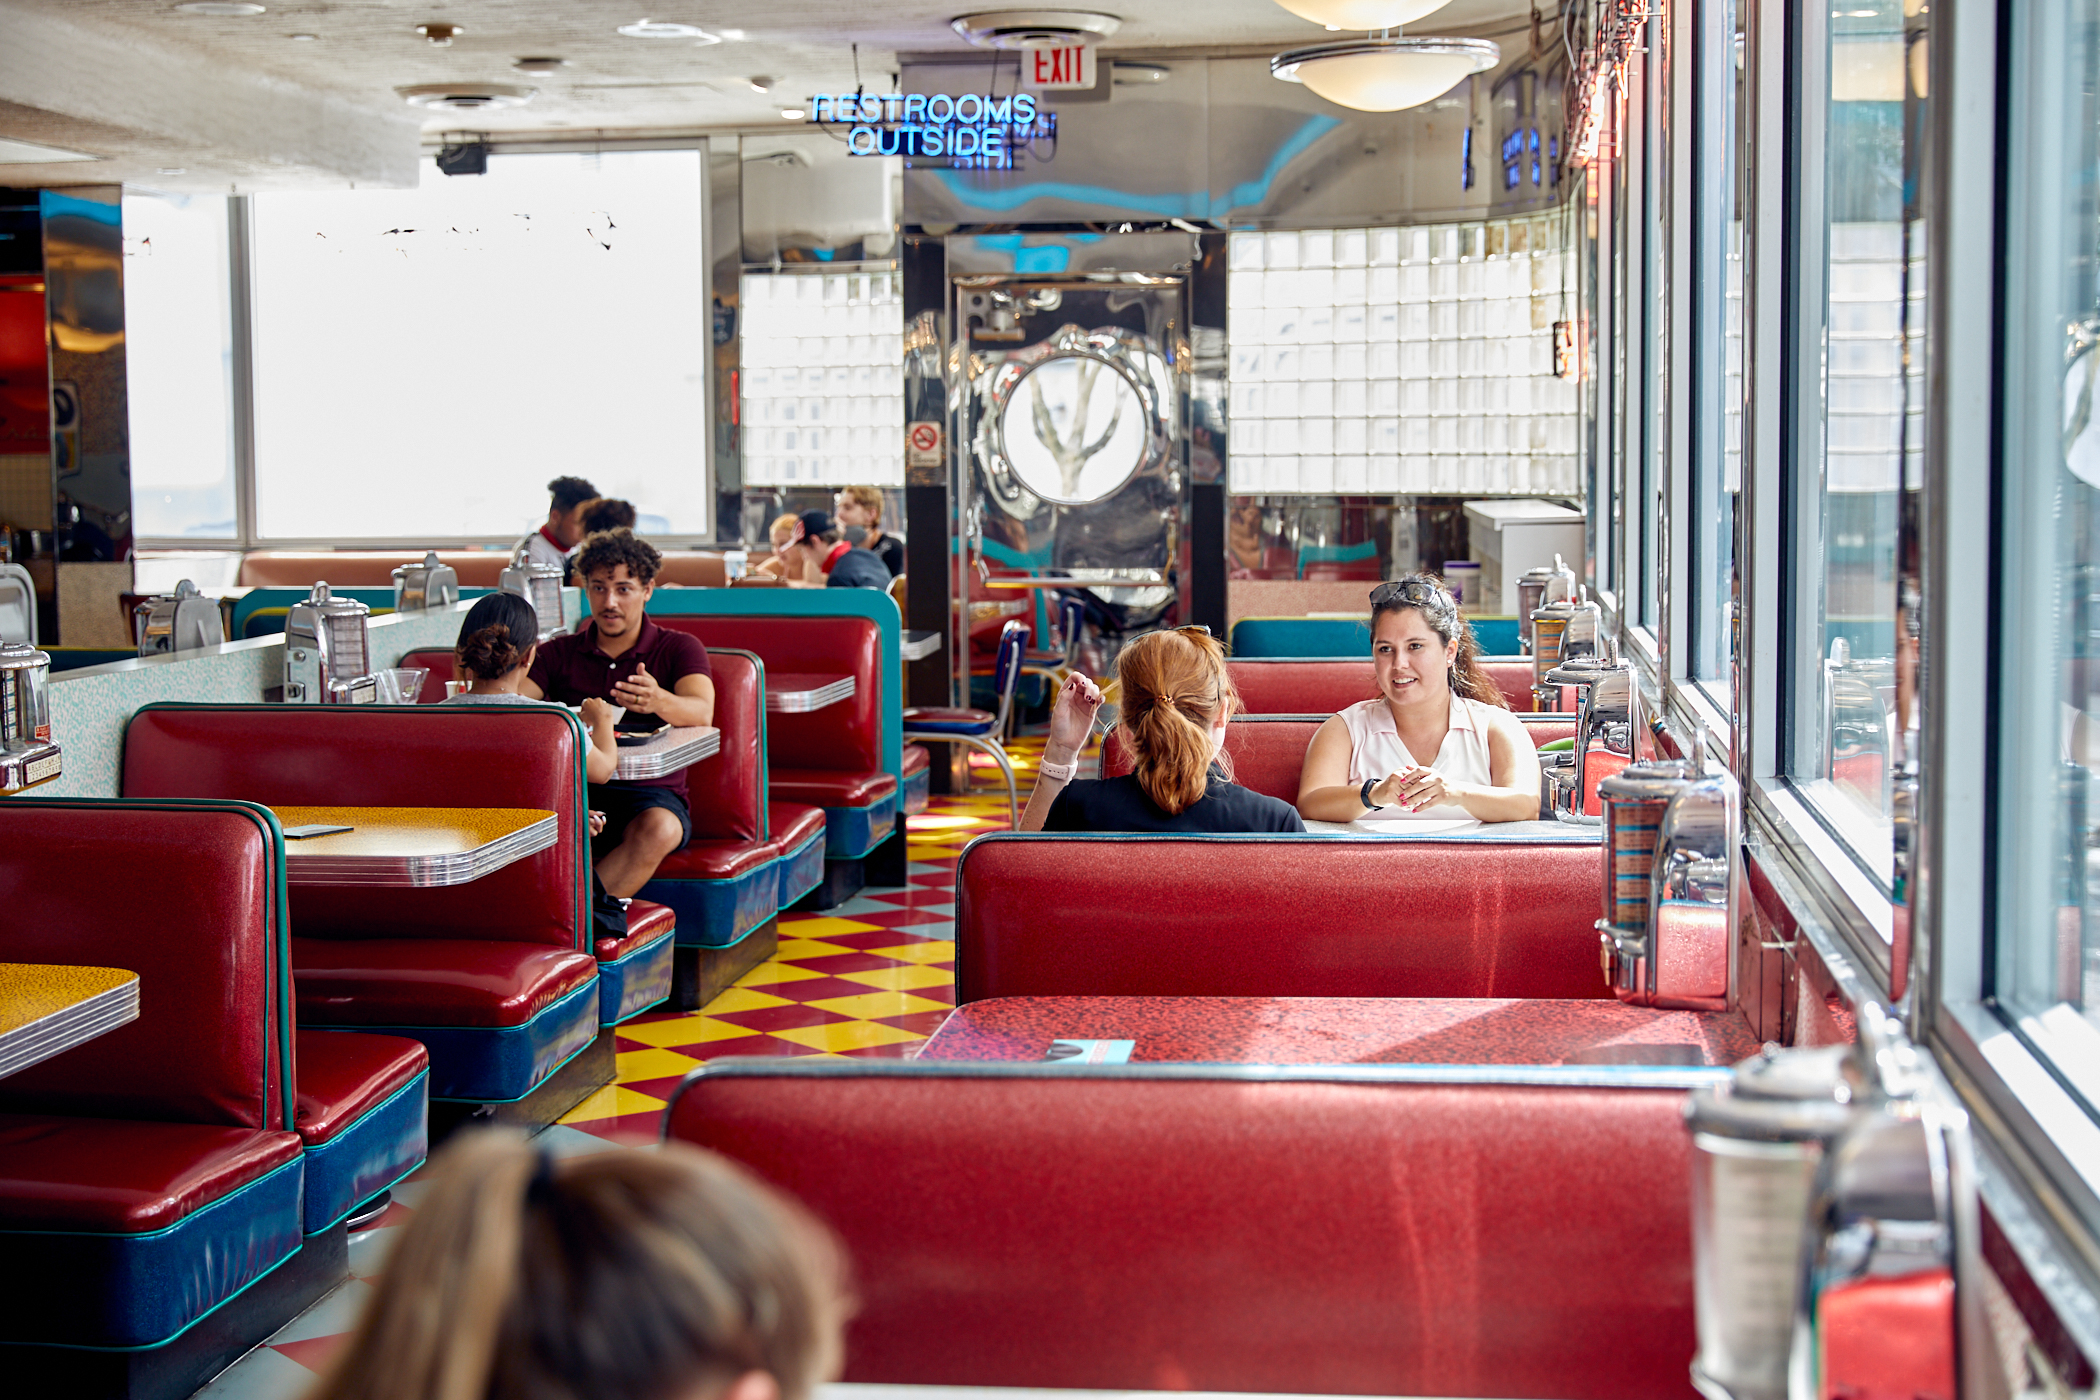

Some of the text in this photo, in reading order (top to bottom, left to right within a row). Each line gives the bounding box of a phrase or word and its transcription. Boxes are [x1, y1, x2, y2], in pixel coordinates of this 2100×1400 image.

[1034, 45, 1085, 83] EXIT
[811, 93, 1036, 124] RESTROOMS
[848, 126, 1003, 157] OUTSIDE
